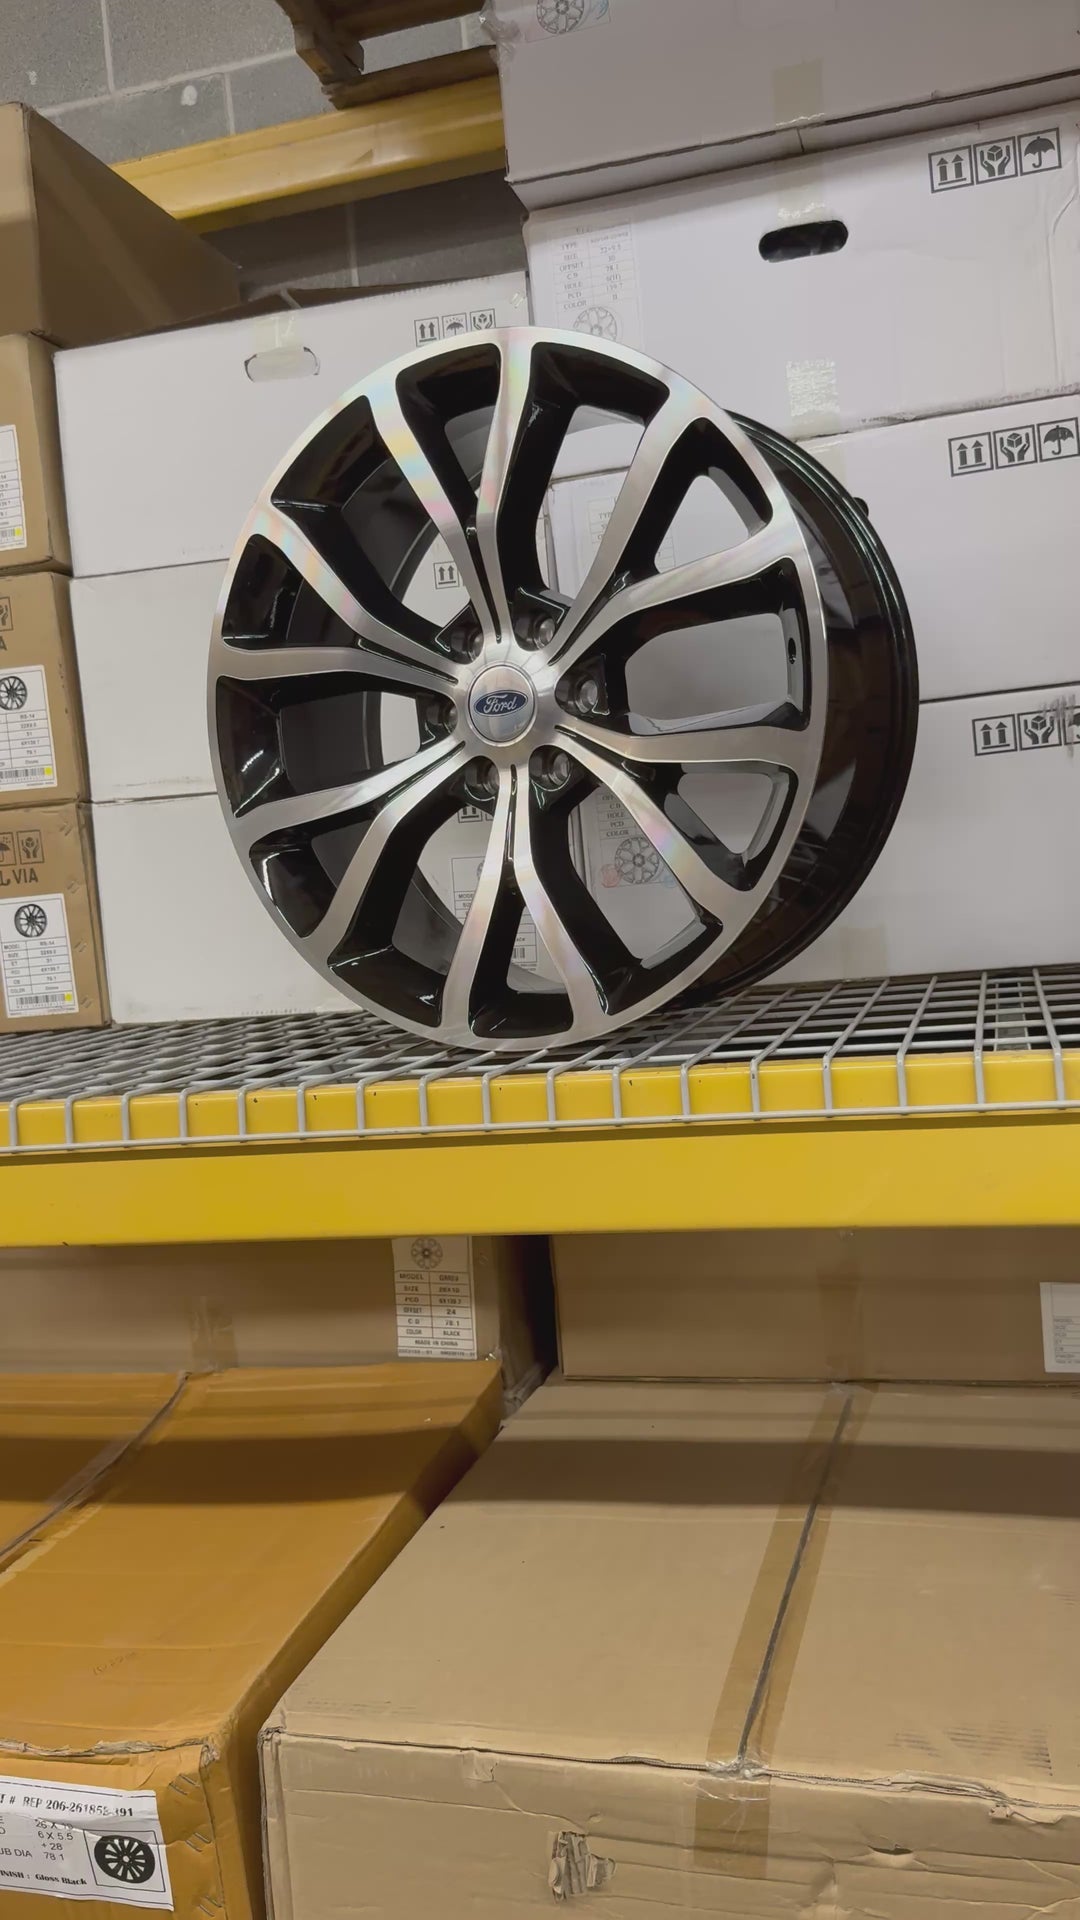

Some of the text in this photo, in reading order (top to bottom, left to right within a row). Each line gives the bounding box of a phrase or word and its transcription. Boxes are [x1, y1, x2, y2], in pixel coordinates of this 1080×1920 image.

[563, 300, 587, 310] COLOR
[483, 694, 517, 714] Ford
[606, 829, 629, 837] COLOR
[10, 1795, 16, 1805] #
[23, 1796, 42, 1809] REP
[50, 1822, 58, 1830] X
[38, 1830, 45, 1839] 6
[46, 1831, 55, 1840] X
[57, 1832, 74, 1841] 5.5
[49, 1842, 64, 1851] 28
[14, 1848, 33, 1858] DIA
[0, 1869, 25, 1879] INISH
[35, 1873, 60, 1883] Gloss
[61, 1877, 88, 1885] Black
